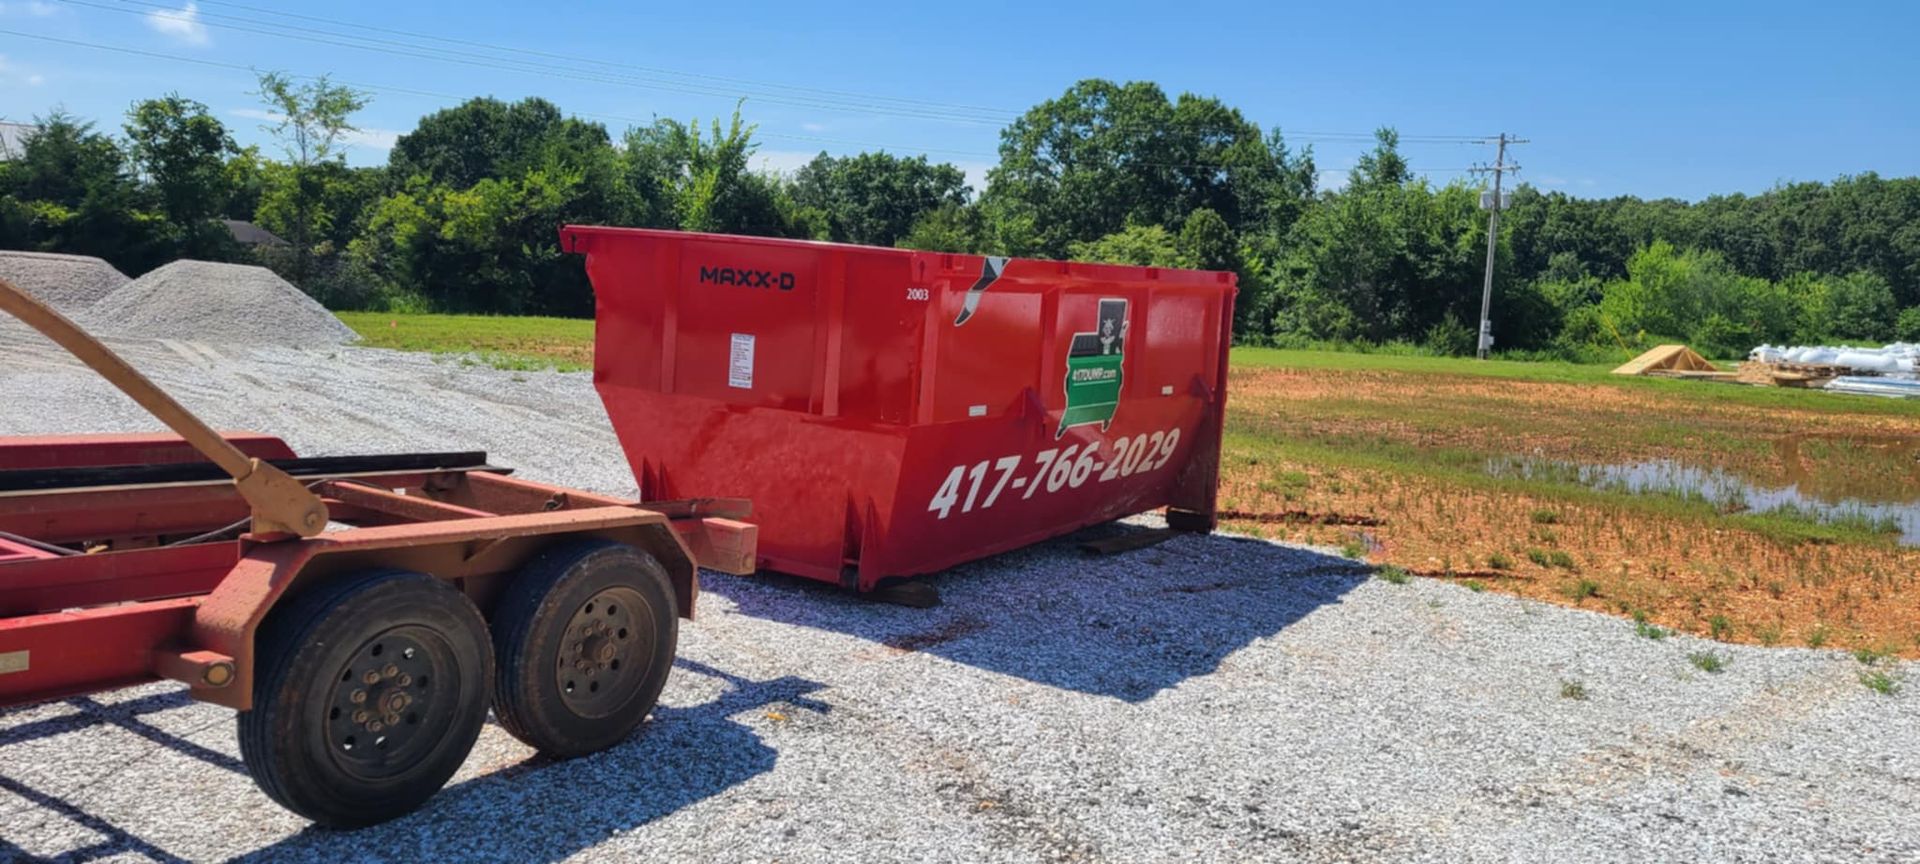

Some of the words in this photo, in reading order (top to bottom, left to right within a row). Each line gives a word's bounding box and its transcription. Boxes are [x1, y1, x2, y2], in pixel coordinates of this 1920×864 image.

[700, 266, 795, 291] MAXX-D
[906, 288, 929, 301] 2003
[928, 428, 1181, 519] 417-766-2029
